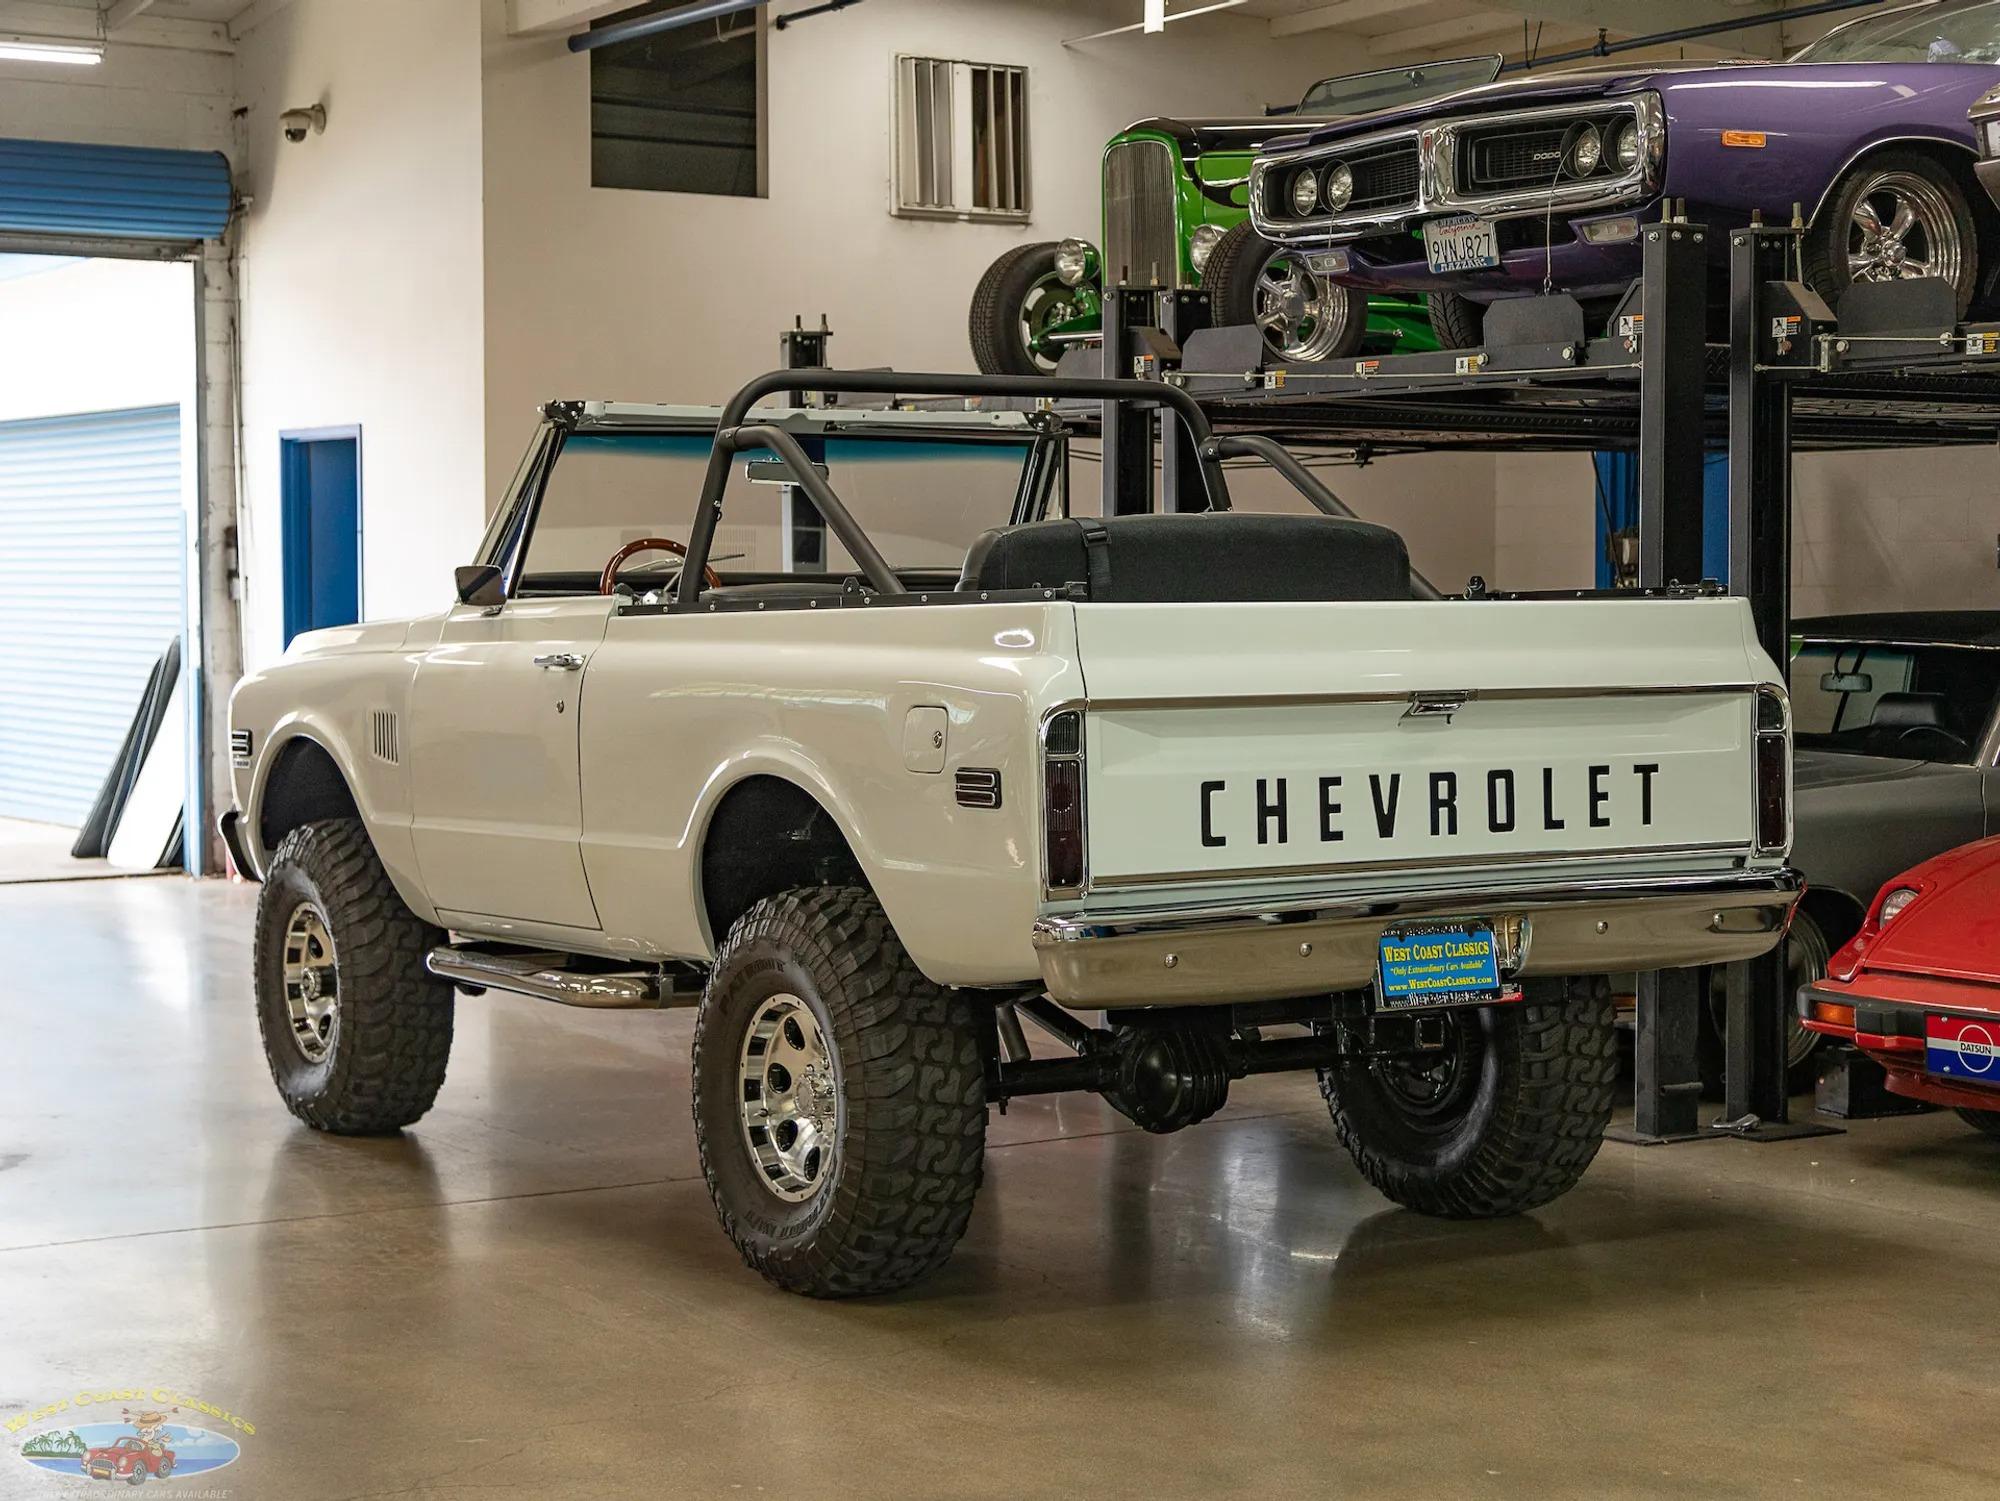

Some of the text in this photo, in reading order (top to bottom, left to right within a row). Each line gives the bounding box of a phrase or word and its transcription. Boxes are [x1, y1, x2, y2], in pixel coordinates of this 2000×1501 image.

[1533, 151, 1561, 161] DODG
[1432, 233, 1490, 263] 9VNJ827
[1200, 763, 1659, 847] CHEVROLET
[1960, 1042, 1992, 1055] DATSUN
